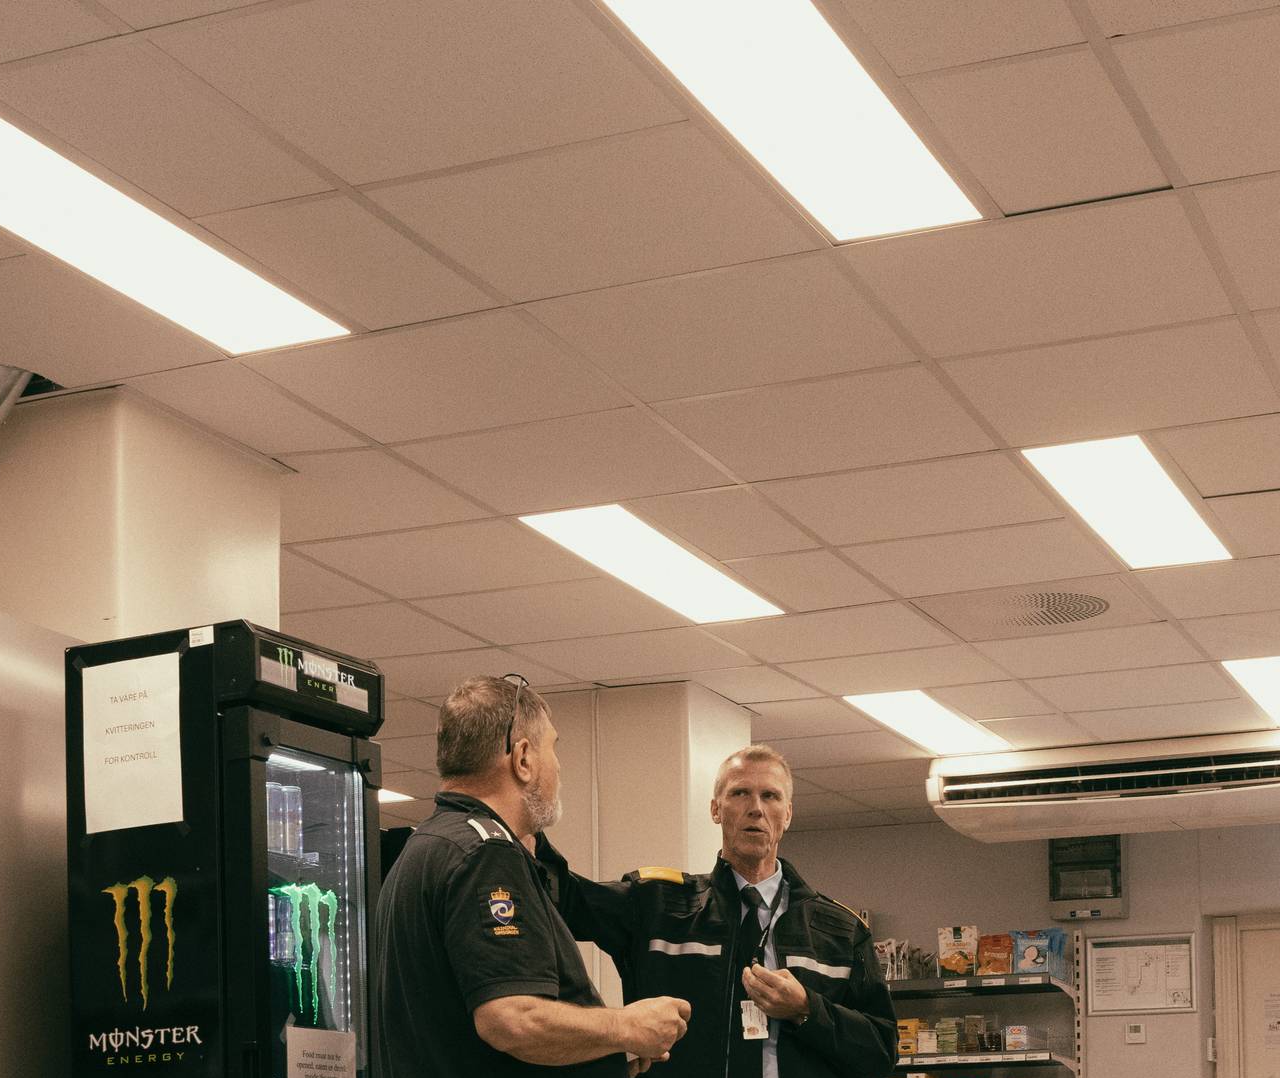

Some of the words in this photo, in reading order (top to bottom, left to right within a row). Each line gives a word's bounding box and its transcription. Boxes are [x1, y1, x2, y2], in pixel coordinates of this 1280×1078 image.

[109, 695, 119, 704] TA
[105, 720, 156, 736] KVITTERINGEN
[104, 756, 119, 766] FOR
[120, 751, 158, 764] KONTROLL
[106, 1050, 186, 1067] ENERGY
